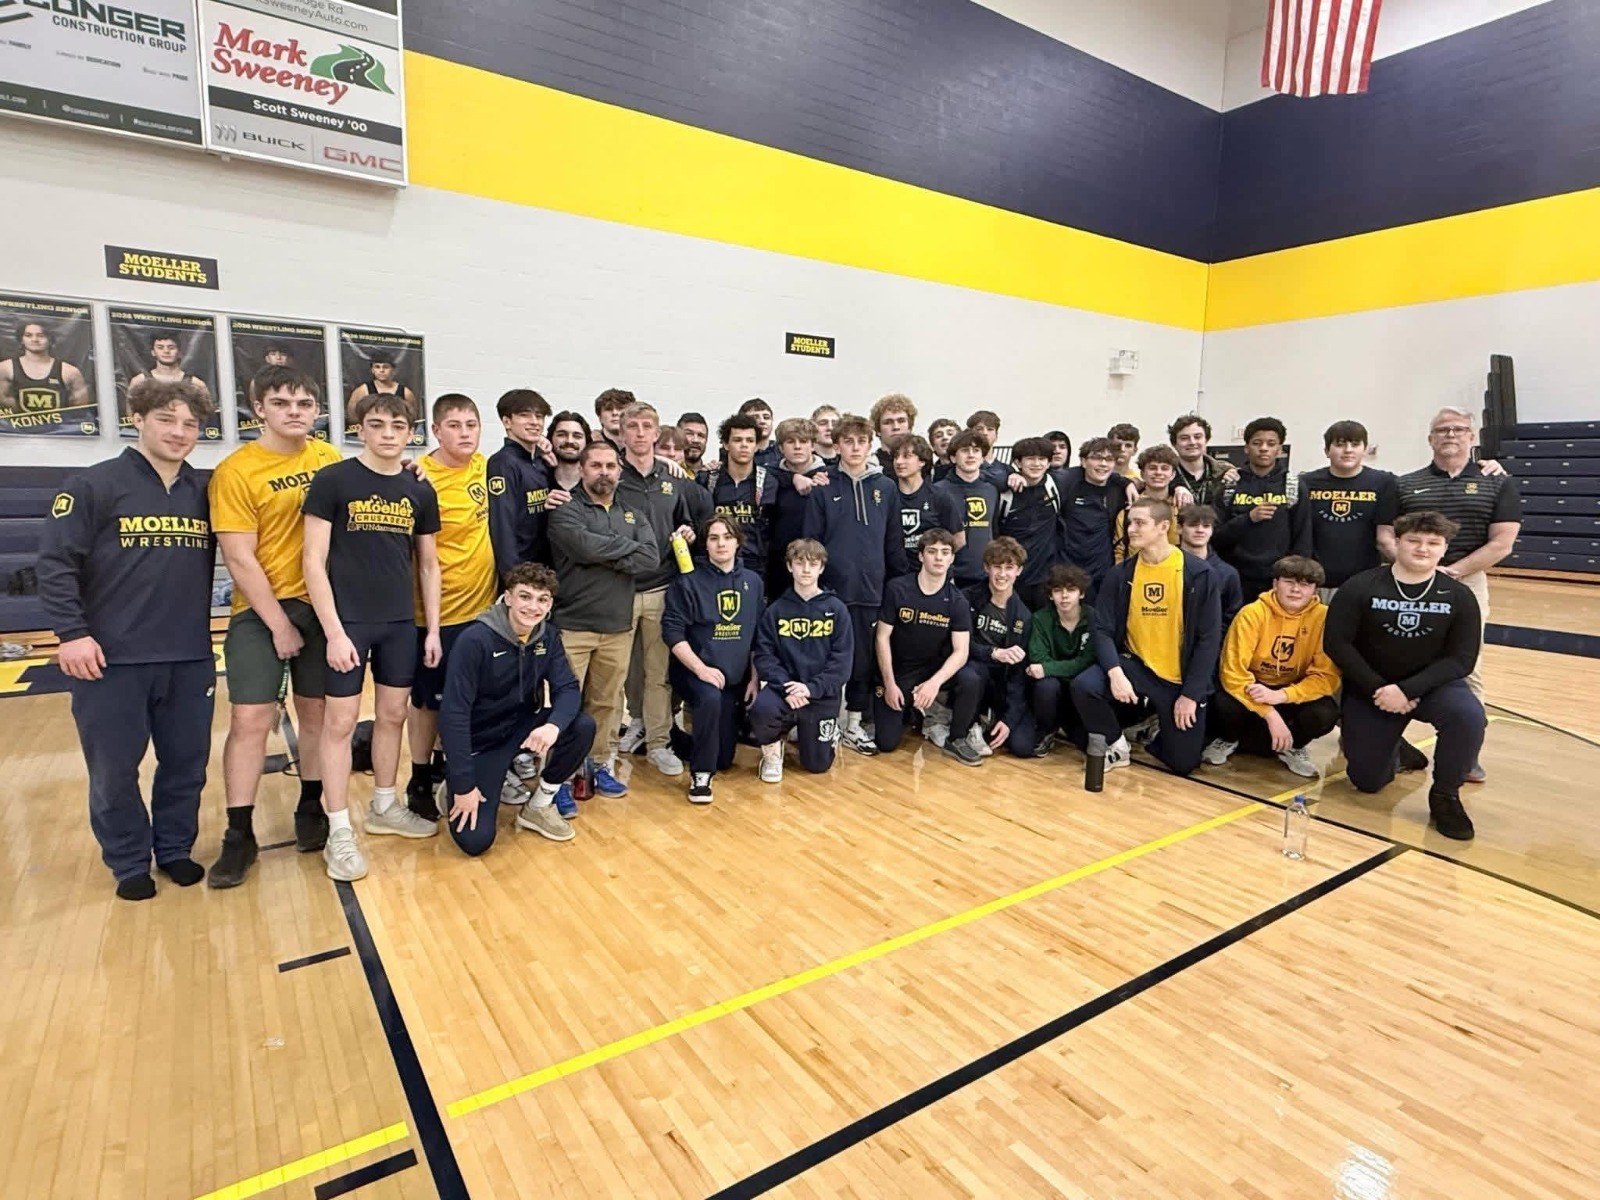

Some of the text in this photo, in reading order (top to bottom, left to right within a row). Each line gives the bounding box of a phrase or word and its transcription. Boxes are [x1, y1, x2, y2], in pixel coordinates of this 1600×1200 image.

[328, 2, 344, 14] Rd
[52, 15, 187, 53] CONSTRUCTION GROUP
[213, 22, 307, 66] Mark
[211, 48, 348, 105] Sweeney
[253, 100, 287, 115] Scott
[290, 108, 344, 128] Sweeney
[243, 132, 400, 172] BUICK GMC
[123, 252, 201, 272] MOELLER
[119, 263, 207, 283] STUDENTS
[793, 337, 828, 347] MOELLER
[791, 344, 830, 355] STUDENTS
[27, 394, 53, 408] M
[11, 413, 63, 428] KONYS
[492, 480, 502, 490] M
[1309, 490, 1377, 501] MOELLER
[355, 501, 413, 517] Moeller
[968, 502, 983, 512] M
[1336, 503, 1347, 511] M
[119, 517, 209, 535] MOELLER
[902, 514, 915, 526] M
[121, 537, 209, 549] WRESTLING
[1148, 587, 1161, 597] M
[722, 597, 735, 610] M
[1371, 597, 1451, 614] MOELLER
[919, 612, 950, 624] Moeller
[1401, 615, 1416, 625] M
